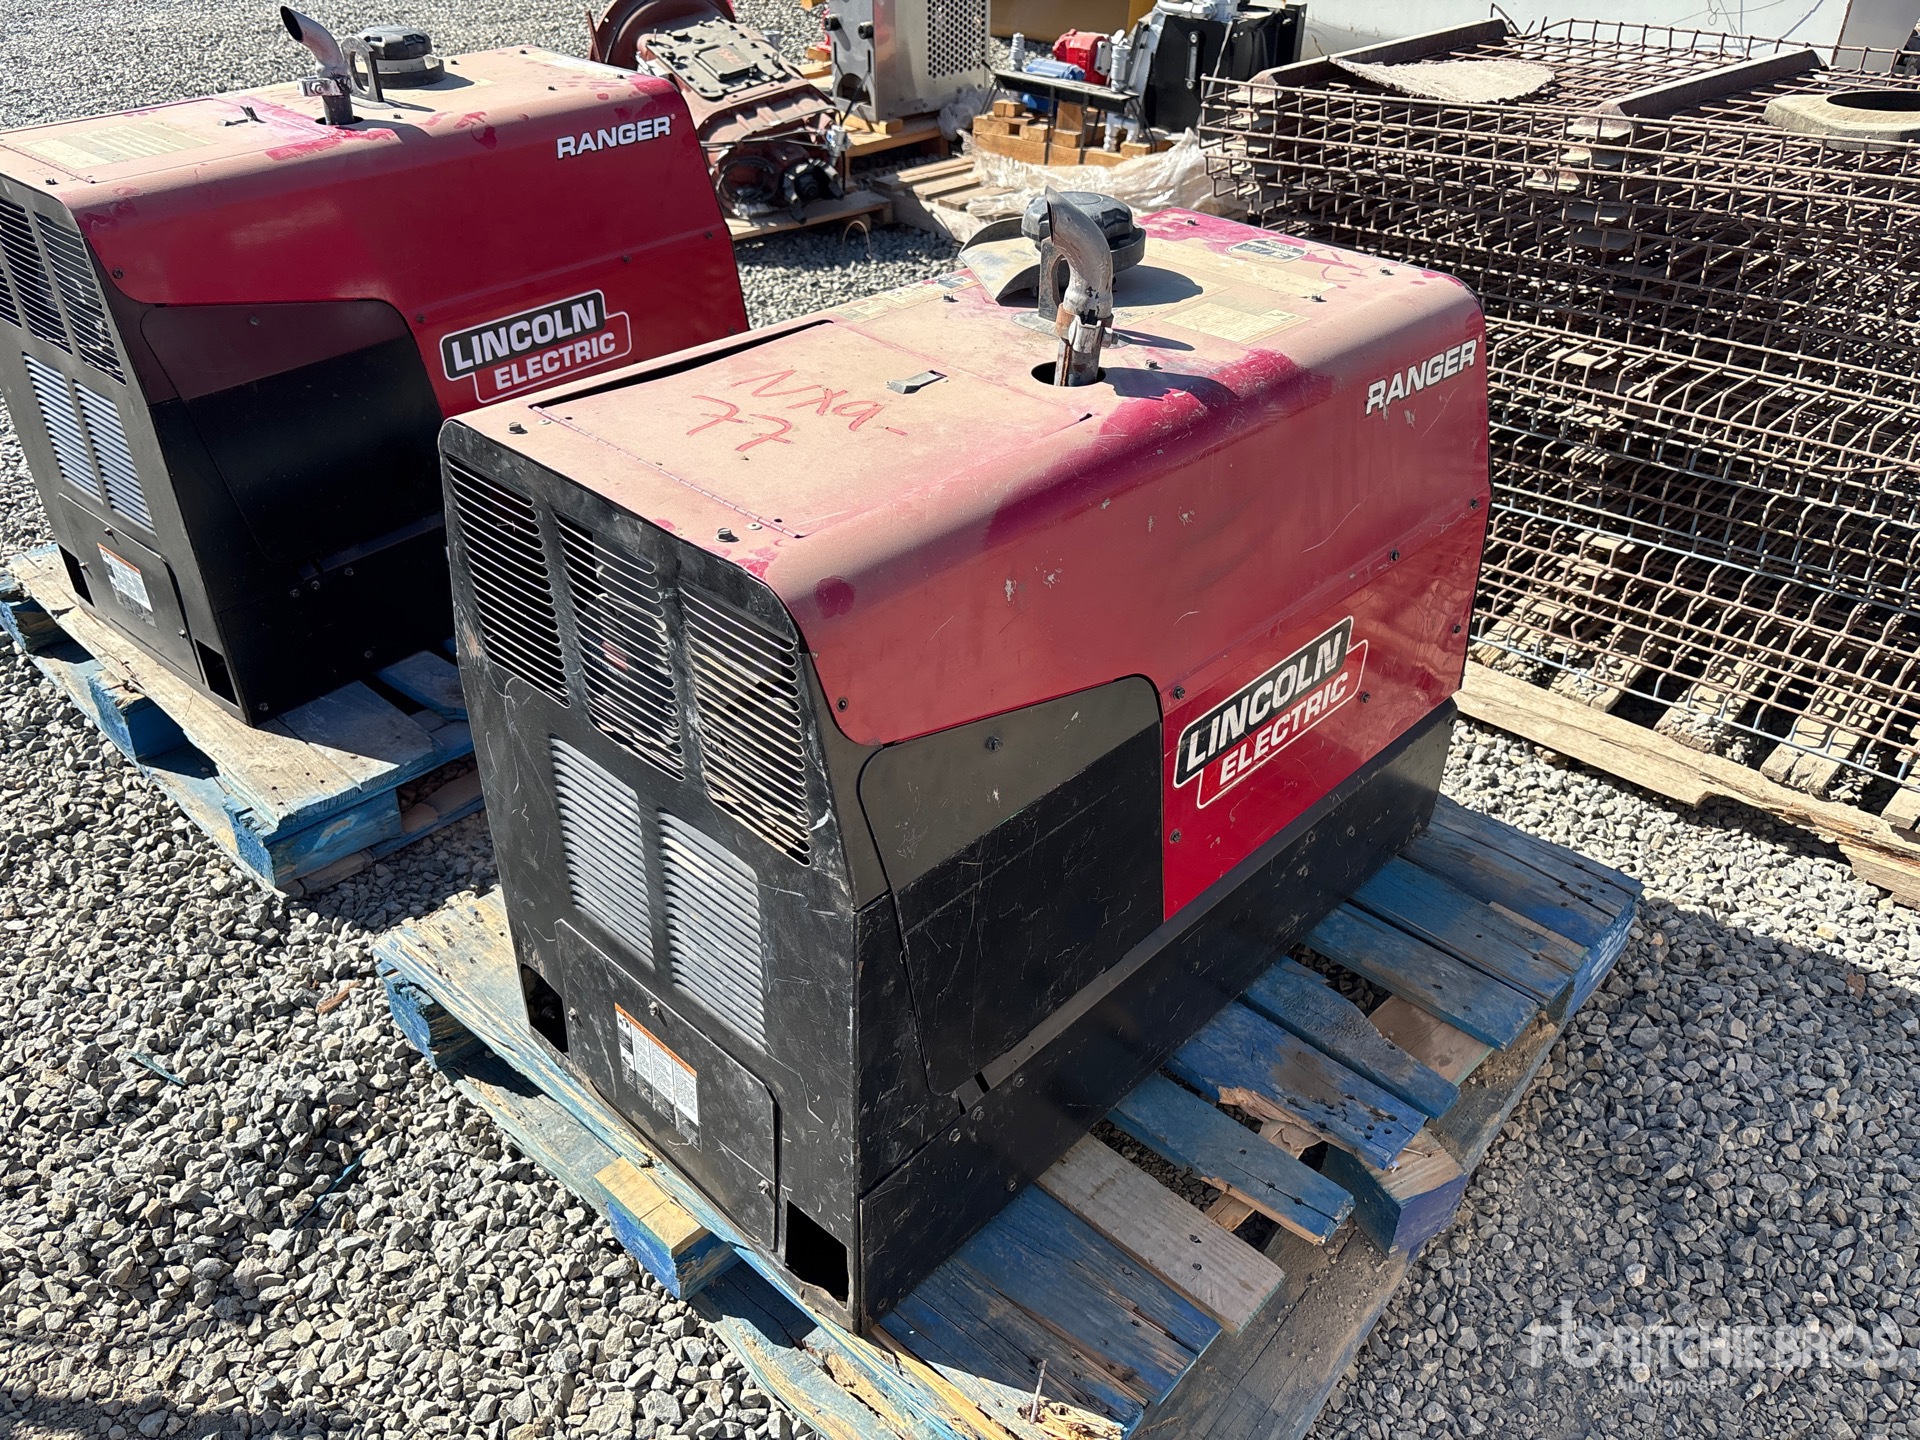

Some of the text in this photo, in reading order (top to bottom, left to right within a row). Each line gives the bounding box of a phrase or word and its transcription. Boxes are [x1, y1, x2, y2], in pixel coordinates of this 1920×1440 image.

[556, 116, 671, 159] RANGER
[451, 300, 597, 371] LINCOLN
[494, 332, 616, 391] ELECTRIC
[1365, 339, 1477, 415] RANGER
[1186, 631, 1343, 772] LINCOLN
[1219, 672, 1349, 786] ELECTRIC
